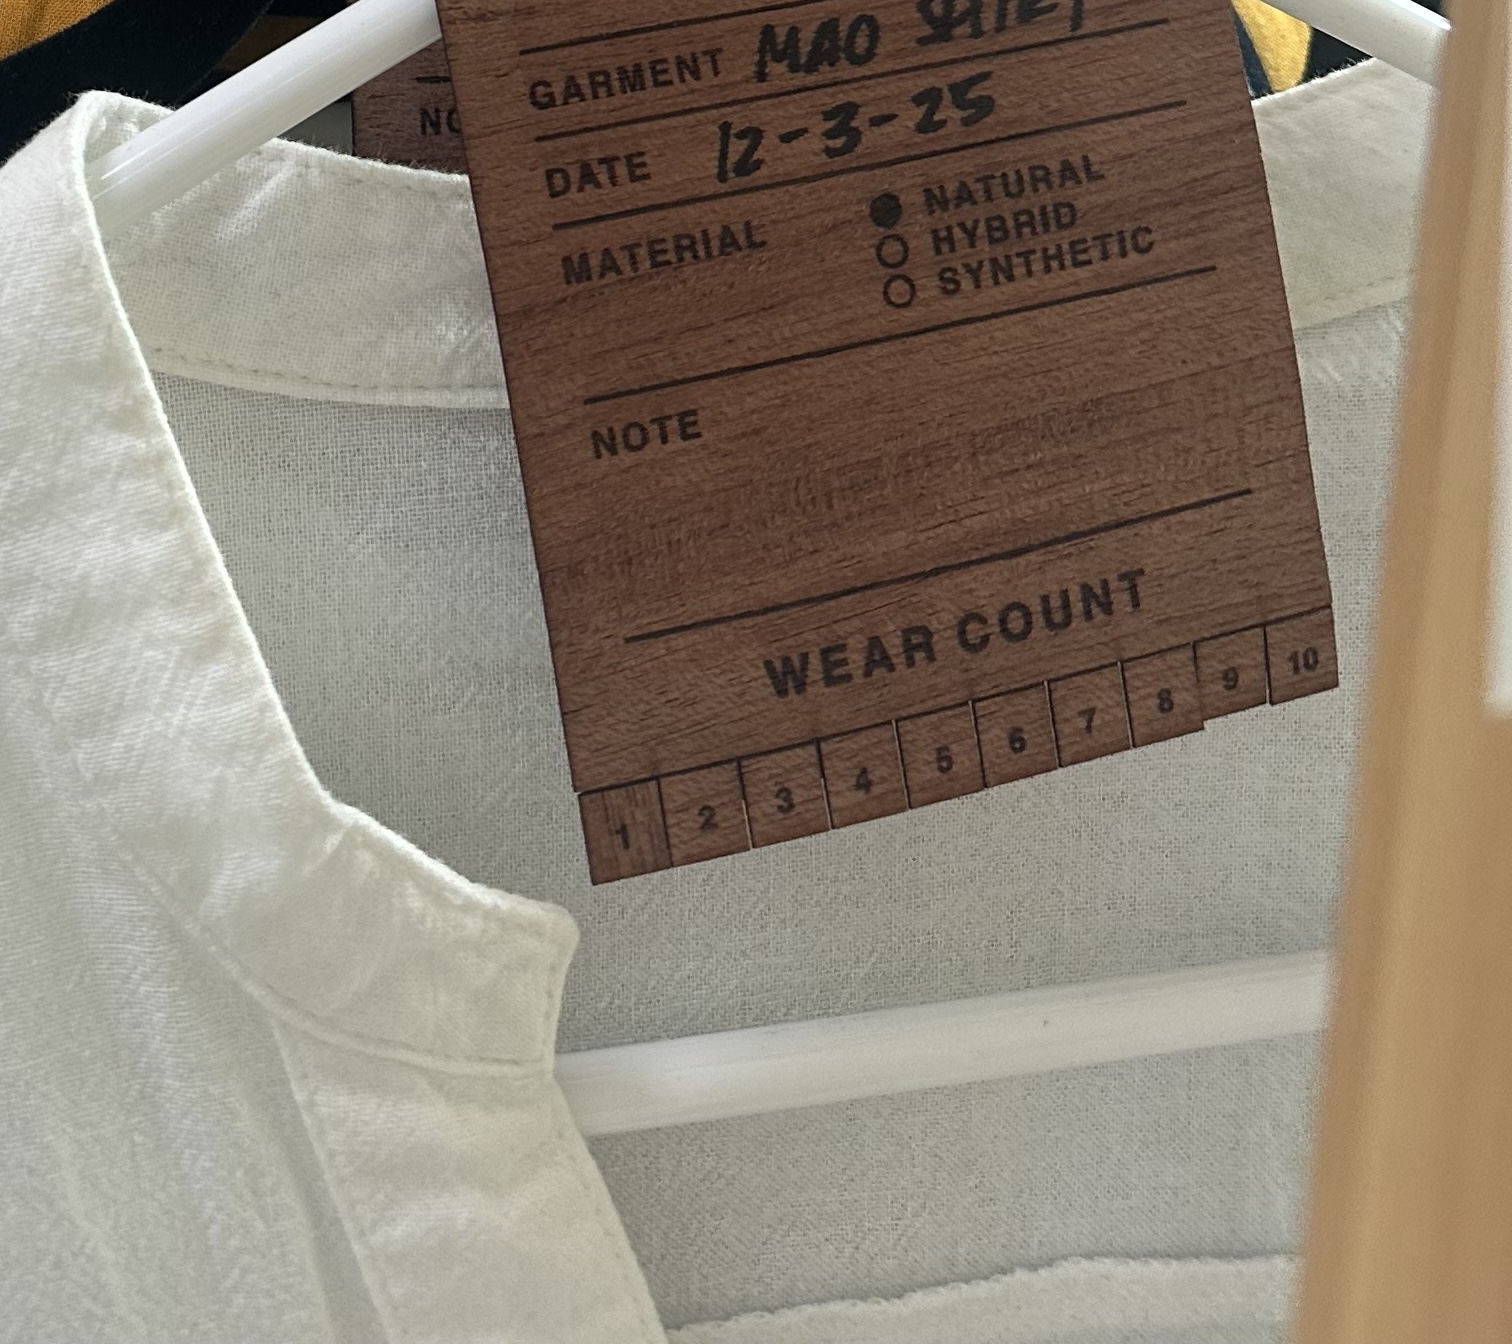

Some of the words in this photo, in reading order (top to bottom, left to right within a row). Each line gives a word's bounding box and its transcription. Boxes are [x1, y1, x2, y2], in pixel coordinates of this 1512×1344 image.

[528, 48, 725, 112] GARMENT
[752, 10, 881, 85] MAO
[715, 71, 997, 185] 12-3-25
[545, 149, 651, 199] DATE
[922, 154, 1105, 216] NATURAL
[560, 218, 769, 288] MATERIAL
[930, 199, 1080, 258] HYBRID
[937, 223, 1157, 296] SYNTHETIC
[590, 408, 703, 460] NOTE
[764, 625, 936, 697] WEAR
[956, 569, 1145, 651] COUNT
[614, 820, 631, 850] 1
[699, 803, 717, 833] 2
[775, 786, 795, 814] 3
[854, 765, 874, 794] 4
[935, 745, 954, 775] 5
[1009, 726, 1027, 755] 6
[1081, 706, 1098, 736] 7
[1156, 687, 1175, 715] 8
[1221, 664, 1240, 694] 9
[1289, 644, 1321, 675] 10
